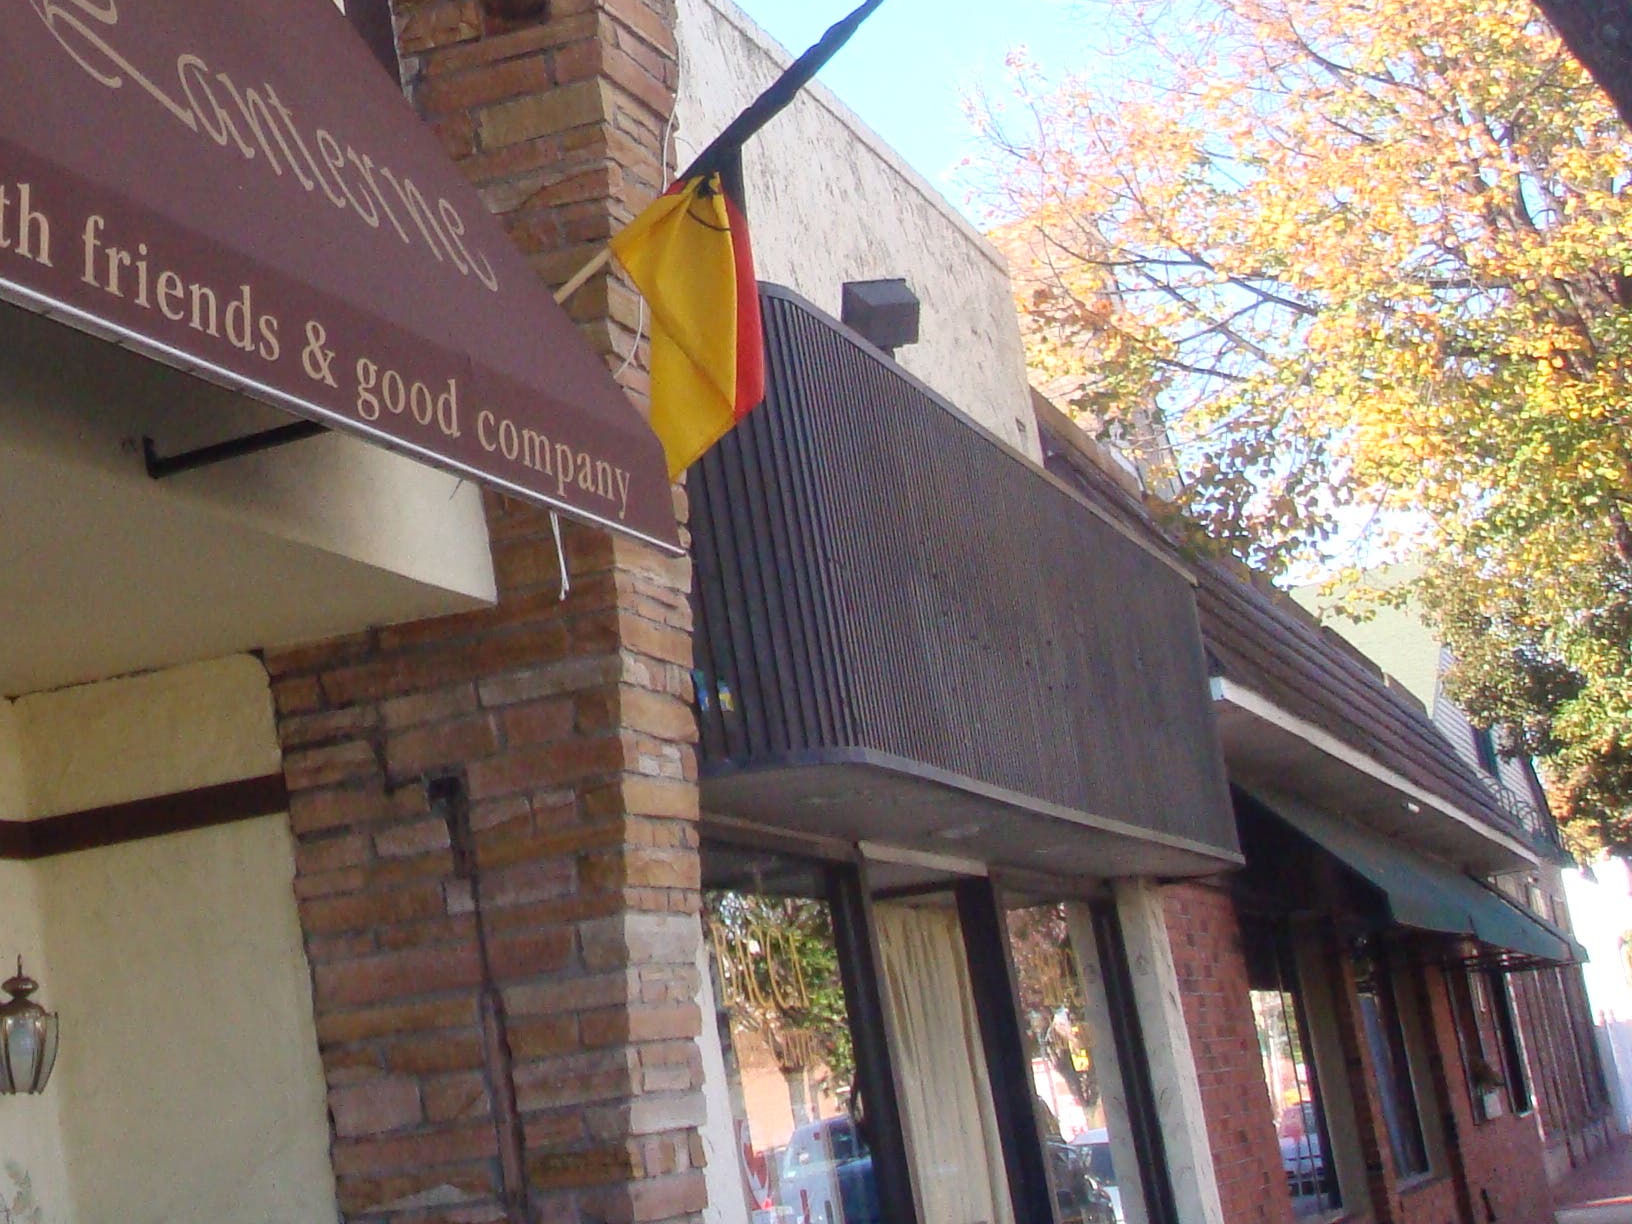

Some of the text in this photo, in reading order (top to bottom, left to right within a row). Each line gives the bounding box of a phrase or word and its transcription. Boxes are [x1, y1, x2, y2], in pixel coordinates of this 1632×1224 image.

[81, 214, 281, 362] friends
[301, 320, 340, 389] &
[355, 356, 462, 440] good
[476, 409, 632, 521] company
